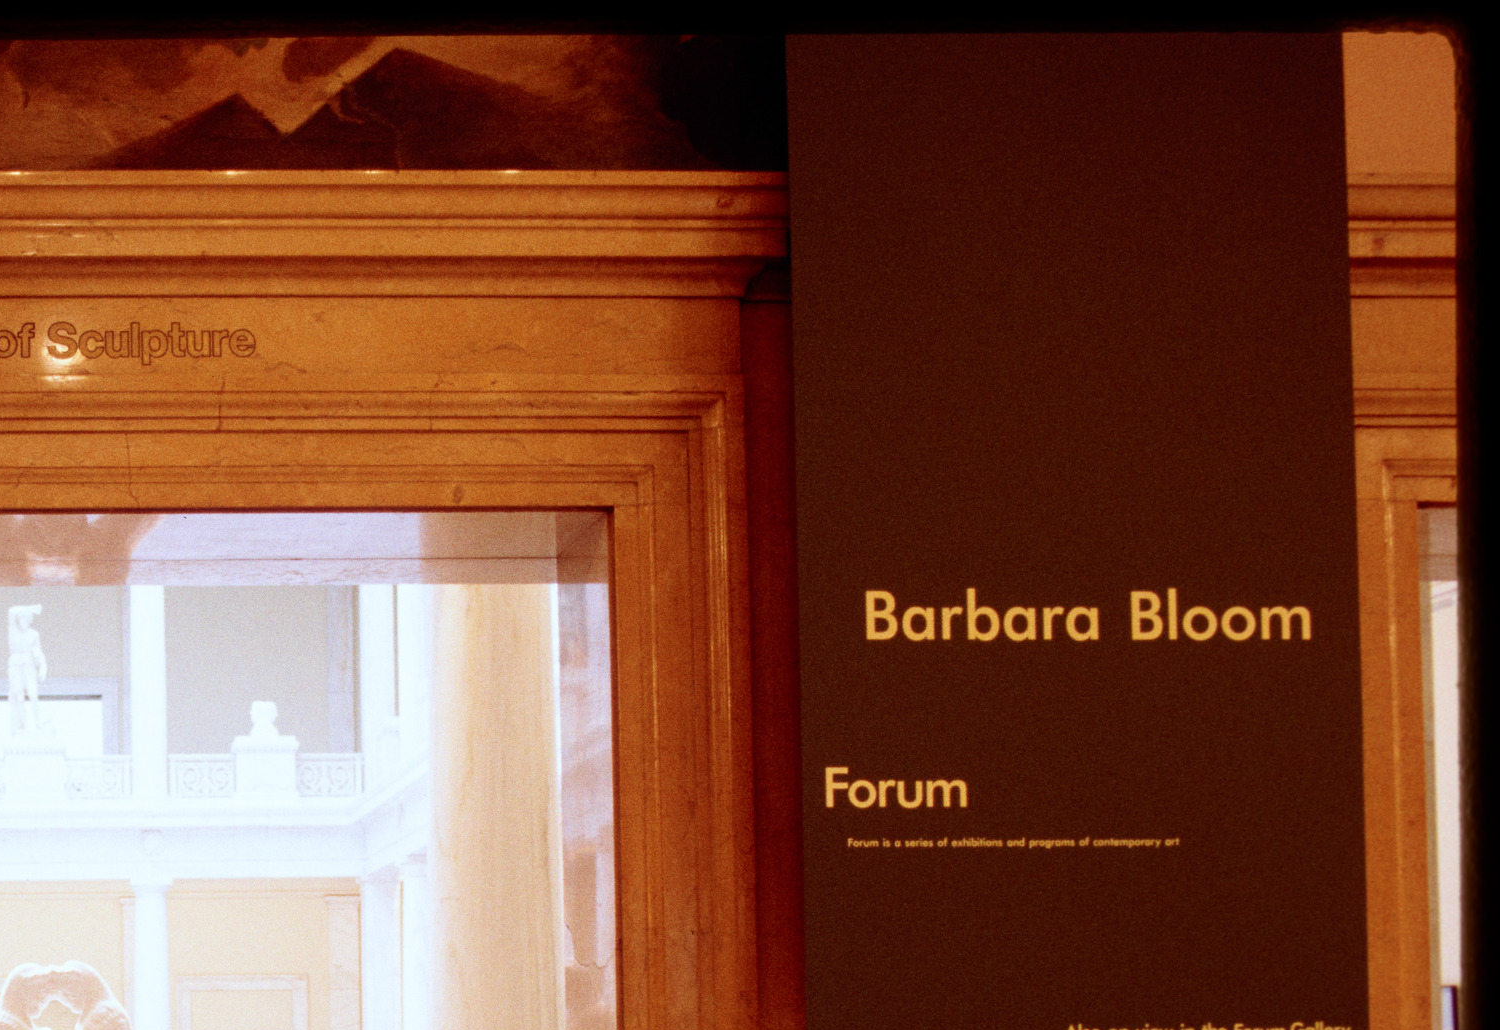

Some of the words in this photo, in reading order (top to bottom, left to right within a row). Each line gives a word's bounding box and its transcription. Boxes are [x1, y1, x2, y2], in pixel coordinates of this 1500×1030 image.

[46, 320, 257, 366] Sculpture
[863, 585, 1102, 644] Barbara
[1128, 585, 1314, 643] Bloom
[823, 764, 971, 811] Forum
[847, 837, 880, 848] Forum
[882, 837, 892, 848] is
[894, 839, 902, 848] a
[904, 837, 934, 848] series
[937, 836, 949, 848] of
[951, 837, 1004, 848] exhibitions
[1006, 836, 1026, 848] and
[1028, 838, 1076, 850] programs
[1078, 836, 1090, 847] of
[1092, 837, 1162, 849] contemporary
[1164, 837, 1181, 847] art
